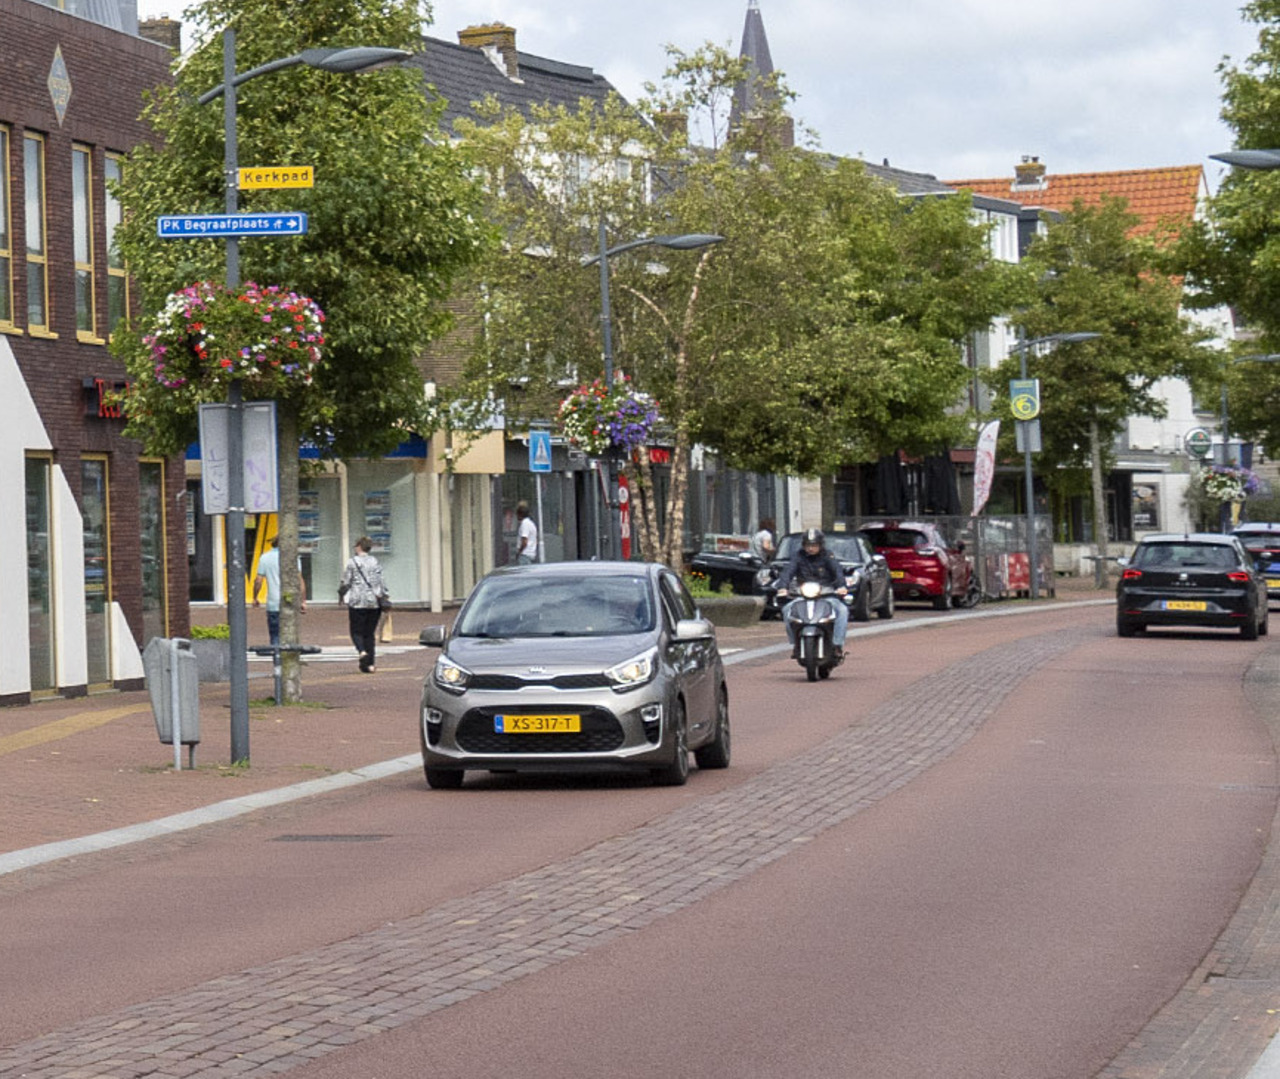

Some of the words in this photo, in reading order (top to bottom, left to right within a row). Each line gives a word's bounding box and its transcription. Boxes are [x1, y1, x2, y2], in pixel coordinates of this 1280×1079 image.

[244, 170, 309, 184] Kerkpad
[163, 221, 180, 231] PK
[184, 218, 270, 233] Begraafplaats
[512, 717, 573, 730] XS-317-T
